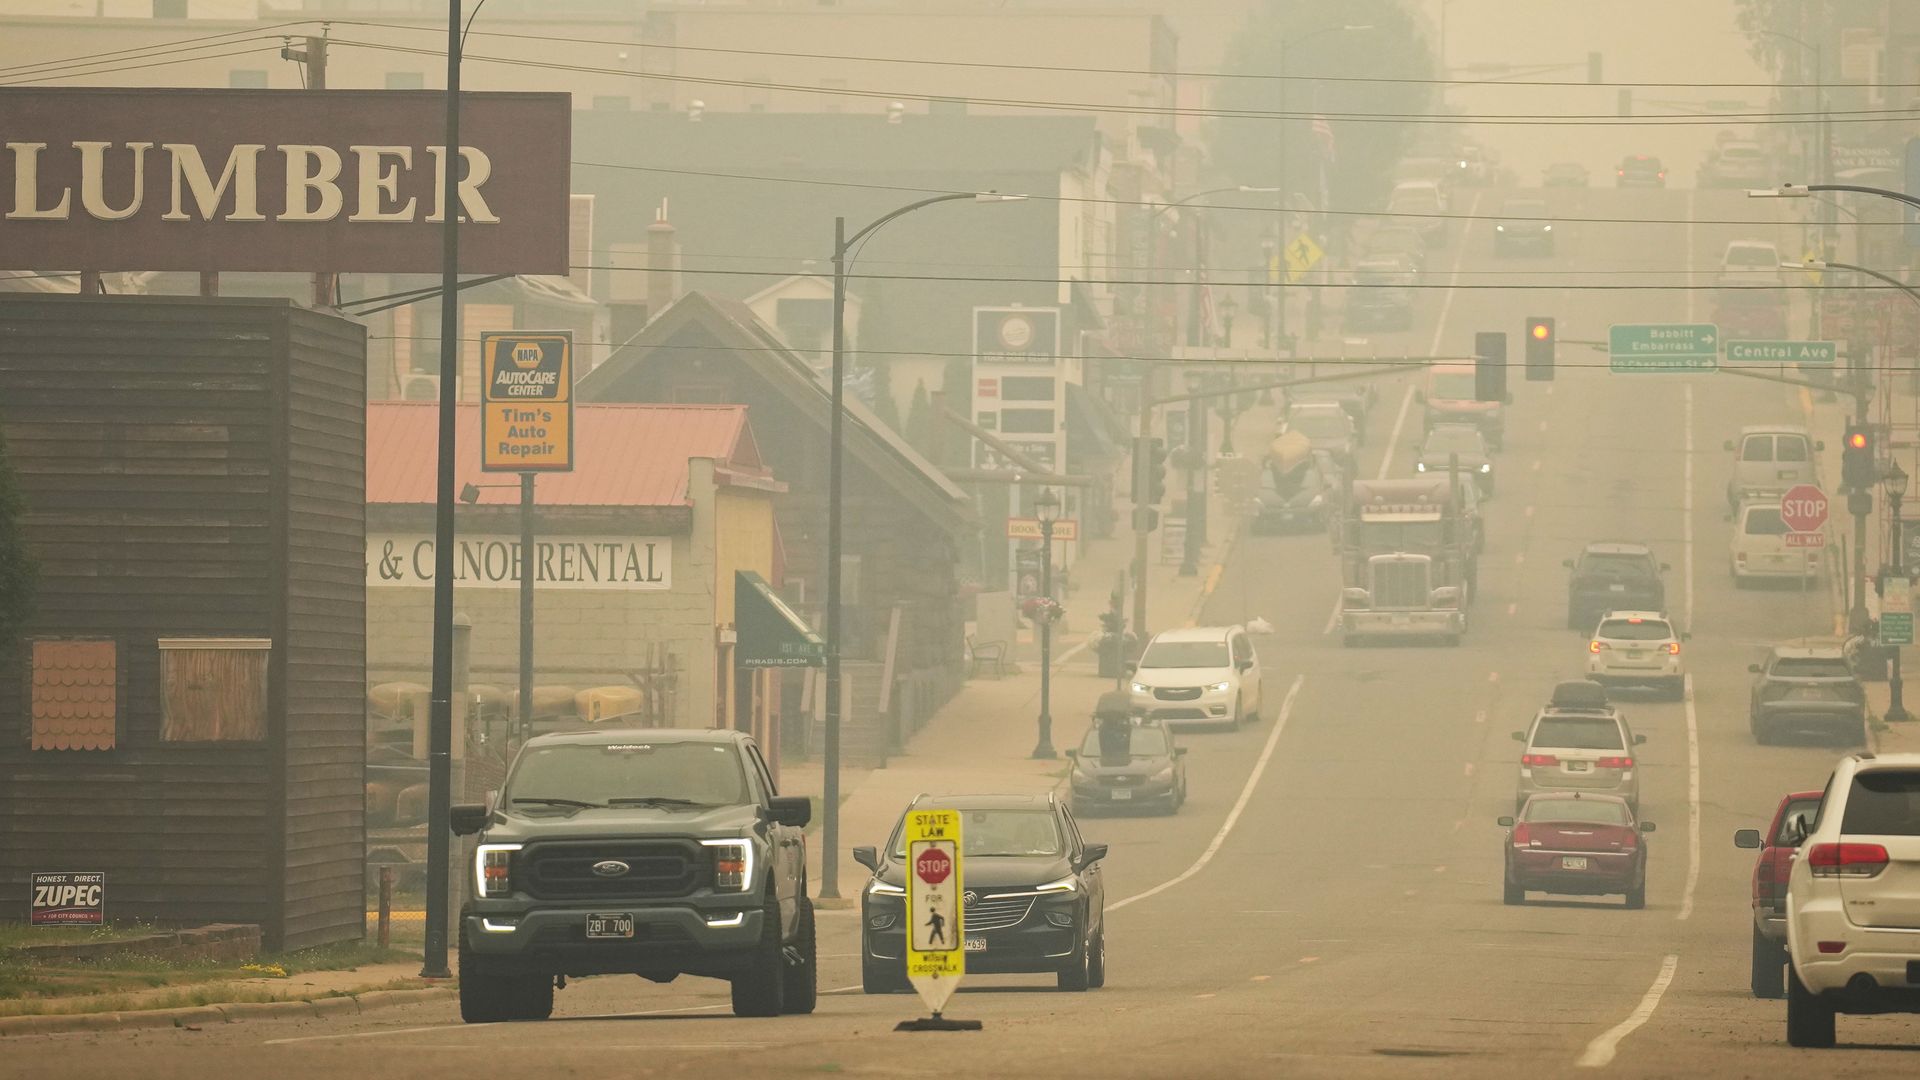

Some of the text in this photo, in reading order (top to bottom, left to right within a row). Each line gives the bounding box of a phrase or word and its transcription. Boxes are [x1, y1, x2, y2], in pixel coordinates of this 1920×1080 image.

[5, 141, 501, 224] LUMBER
[1650, 329, 1694, 338] Babbitt
[1632, 341, 1694, 351] Embarrass
[1733, 345, 1828, 357] Central Ave
[517, 349, 539, 362] NAPA
[508, 385, 544, 396] CENTER
[502, 409, 552, 422] Tim's
[508, 425, 547, 438] Auto
[499, 442, 555, 458] Repair
[1784, 499, 1826, 518] STOP
[1787, 535, 1823, 545] ALL WAY
[378, 539, 403, 582] &
[536, 542, 663, 583] RENTAL
[915, 814, 950, 826] STATE
[921, 827, 944, 838] LAW
[919, 860, 949, 873] STOP
[36, 875, 67, 883] HONEST.
[33, 885, 102, 907] ZUPEC
[925, 894, 943, 902] FOR
[589, 920, 631, 932] ZBT 700
[912, 964, 957, 973] CROSSWALK
